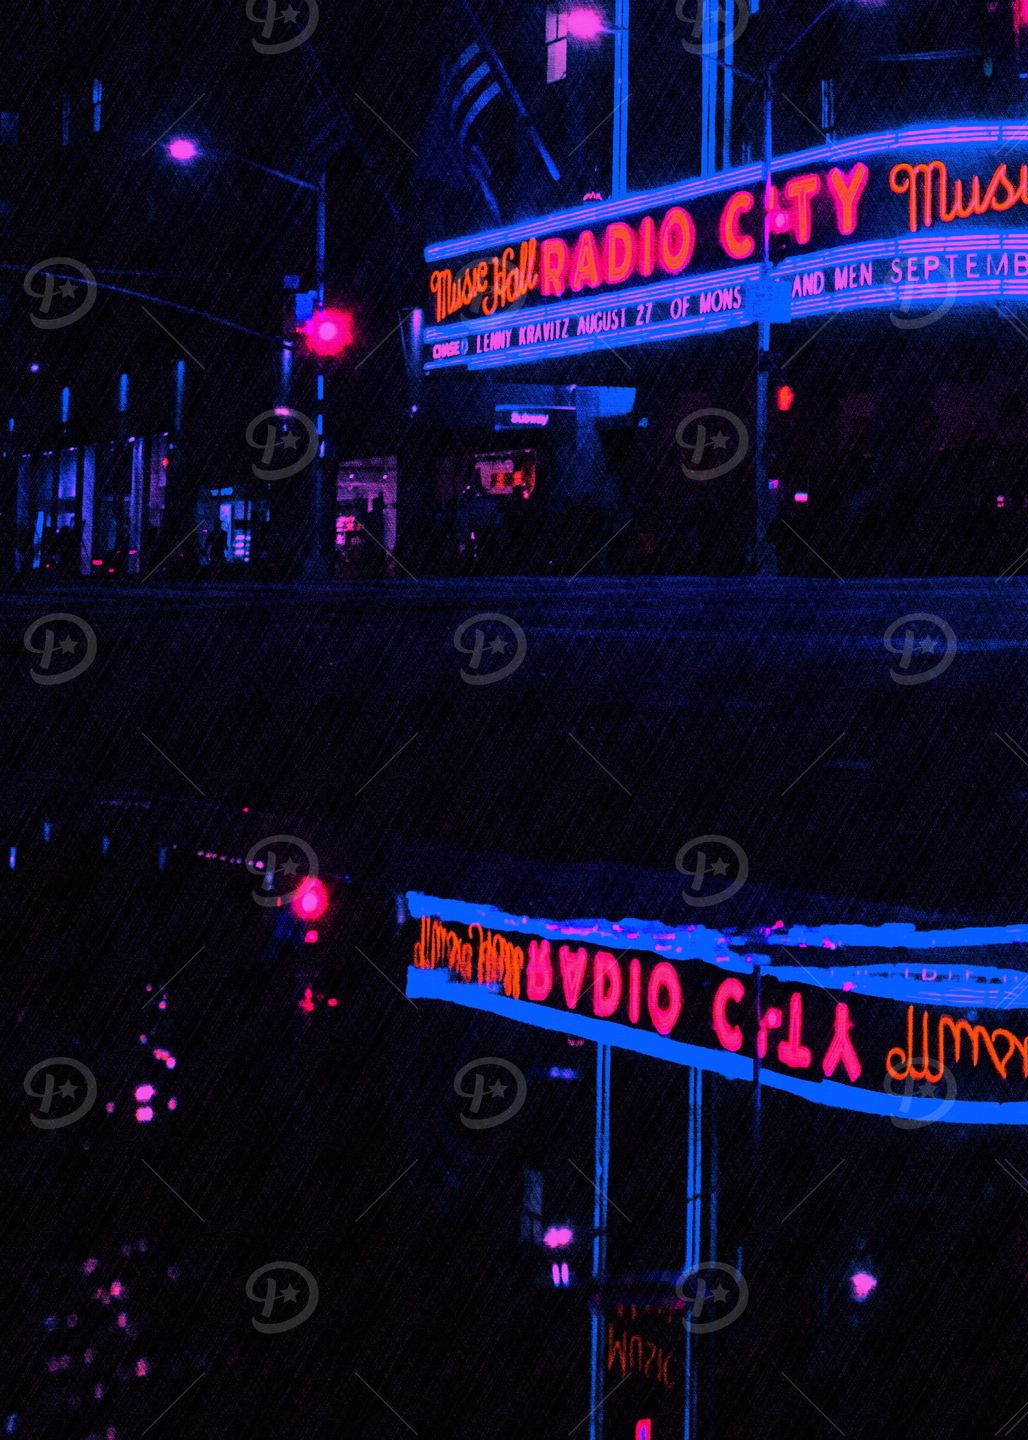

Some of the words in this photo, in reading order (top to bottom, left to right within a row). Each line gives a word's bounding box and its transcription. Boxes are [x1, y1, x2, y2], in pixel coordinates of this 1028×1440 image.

[481, 237, 539, 316] Hall
[540, 205, 697, 298] RADIO
[791, 270, 825, 299] AND
[834, 260, 874, 292] MEN
[476, 328, 513, 355] LENNY
[518, 317, 571, 347] KRAVITZ
[576, 306, 627, 336] AUGUST
[635, 301, 654, 327] 27
[669, 295, 692, 321] OF
